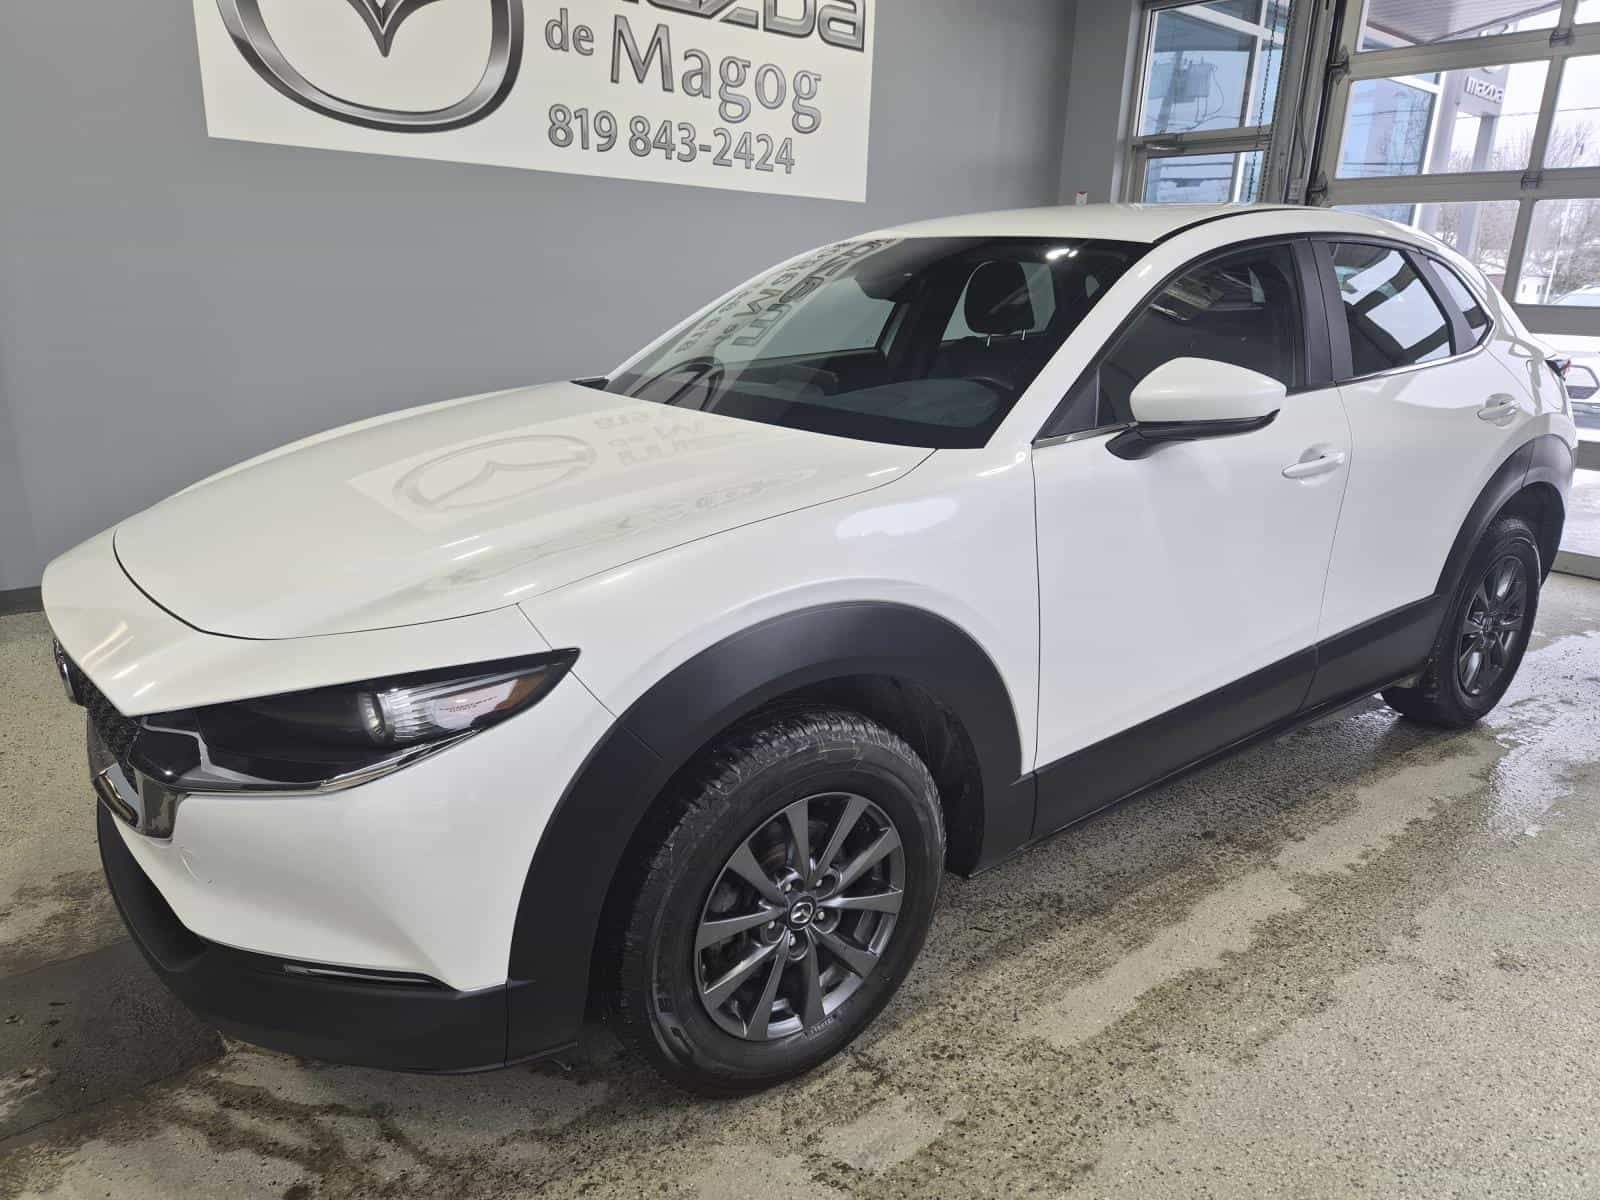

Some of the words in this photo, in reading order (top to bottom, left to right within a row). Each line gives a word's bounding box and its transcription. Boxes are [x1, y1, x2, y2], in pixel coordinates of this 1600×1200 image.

[545, 8, 594, 56] de
[610, 14, 822, 134] Magog
[548, 104, 618, 152] 819
[628, 115, 796, 174] 843-2424
